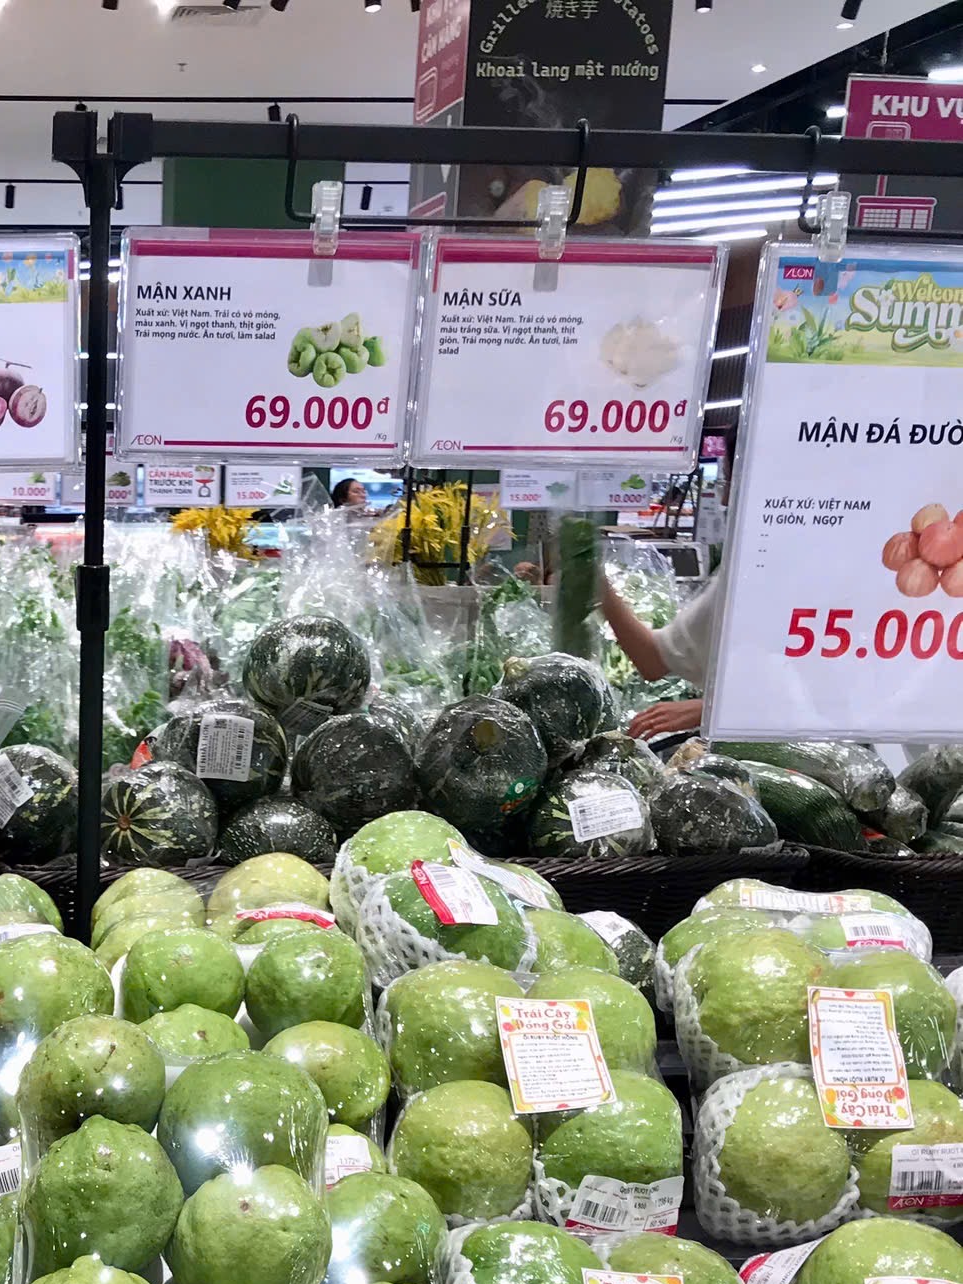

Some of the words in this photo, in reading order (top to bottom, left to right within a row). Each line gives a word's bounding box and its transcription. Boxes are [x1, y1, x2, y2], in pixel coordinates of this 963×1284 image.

[476, 62, 525, 77] Khoai
[532, 61, 570, 81] lang
[575, 59, 605, 80] mật
[611, 60, 659, 81] nướng
[872, 94, 929, 117] KHU
[137, 281, 177, 303] MẬN
[183, 286, 232, 300] XANH
[443, 288, 483, 309] MẬN
[488, 289, 522, 306] SỮA
[136, 308, 153, 317] Xuất
[155, 309, 170, 317] xứ:
[172, 309, 188, 318] Việt
[190, 310, 212, 318] Nam.
[214, 309, 229, 318] Trái
[231, 310, 241, 318] có
[243, 310, 253, 318] vỏ
[255, 310, 280, 320] mỏng,
[135, 319, 153, 327] màu
[155, 319, 177, 327] xanh.
[180, 320, 188, 329] Vị
[190, 321, 209, 330] ngọt
[211, 320, 237, 330] thanh,
[239, 321, 254, 329] thịt
[256, 321, 276, 331] giòn.
[135, 330, 150, 338] Trái
[153, 331, 175, 340] mọng
[178, 330, 200, 338] nước.
[203, 330, 214, 338] Ăn
[216, 331, 235, 340] tươi,
[238, 331, 252, 339] làm
[254, 332, 275, 340] salad
[245, 395, 390, 430] 69.000đ
[544, 400, 687, 433] 69.000đ
[798, 416, 858, 447] MẬN
[866, 417, 901, 444] ĐÁ
[765, 497, 793, 509] XUẤT
[797, 498, 815, 509] XỨ:
[818, 497, 841, 512] VIỆT
[844, 501, 871, 510] NAM
[763, 514, 773, 526] VỊ
[776, 513, 806, 526] GIÒN,
[813, 515, 844, 527] NGỌT
